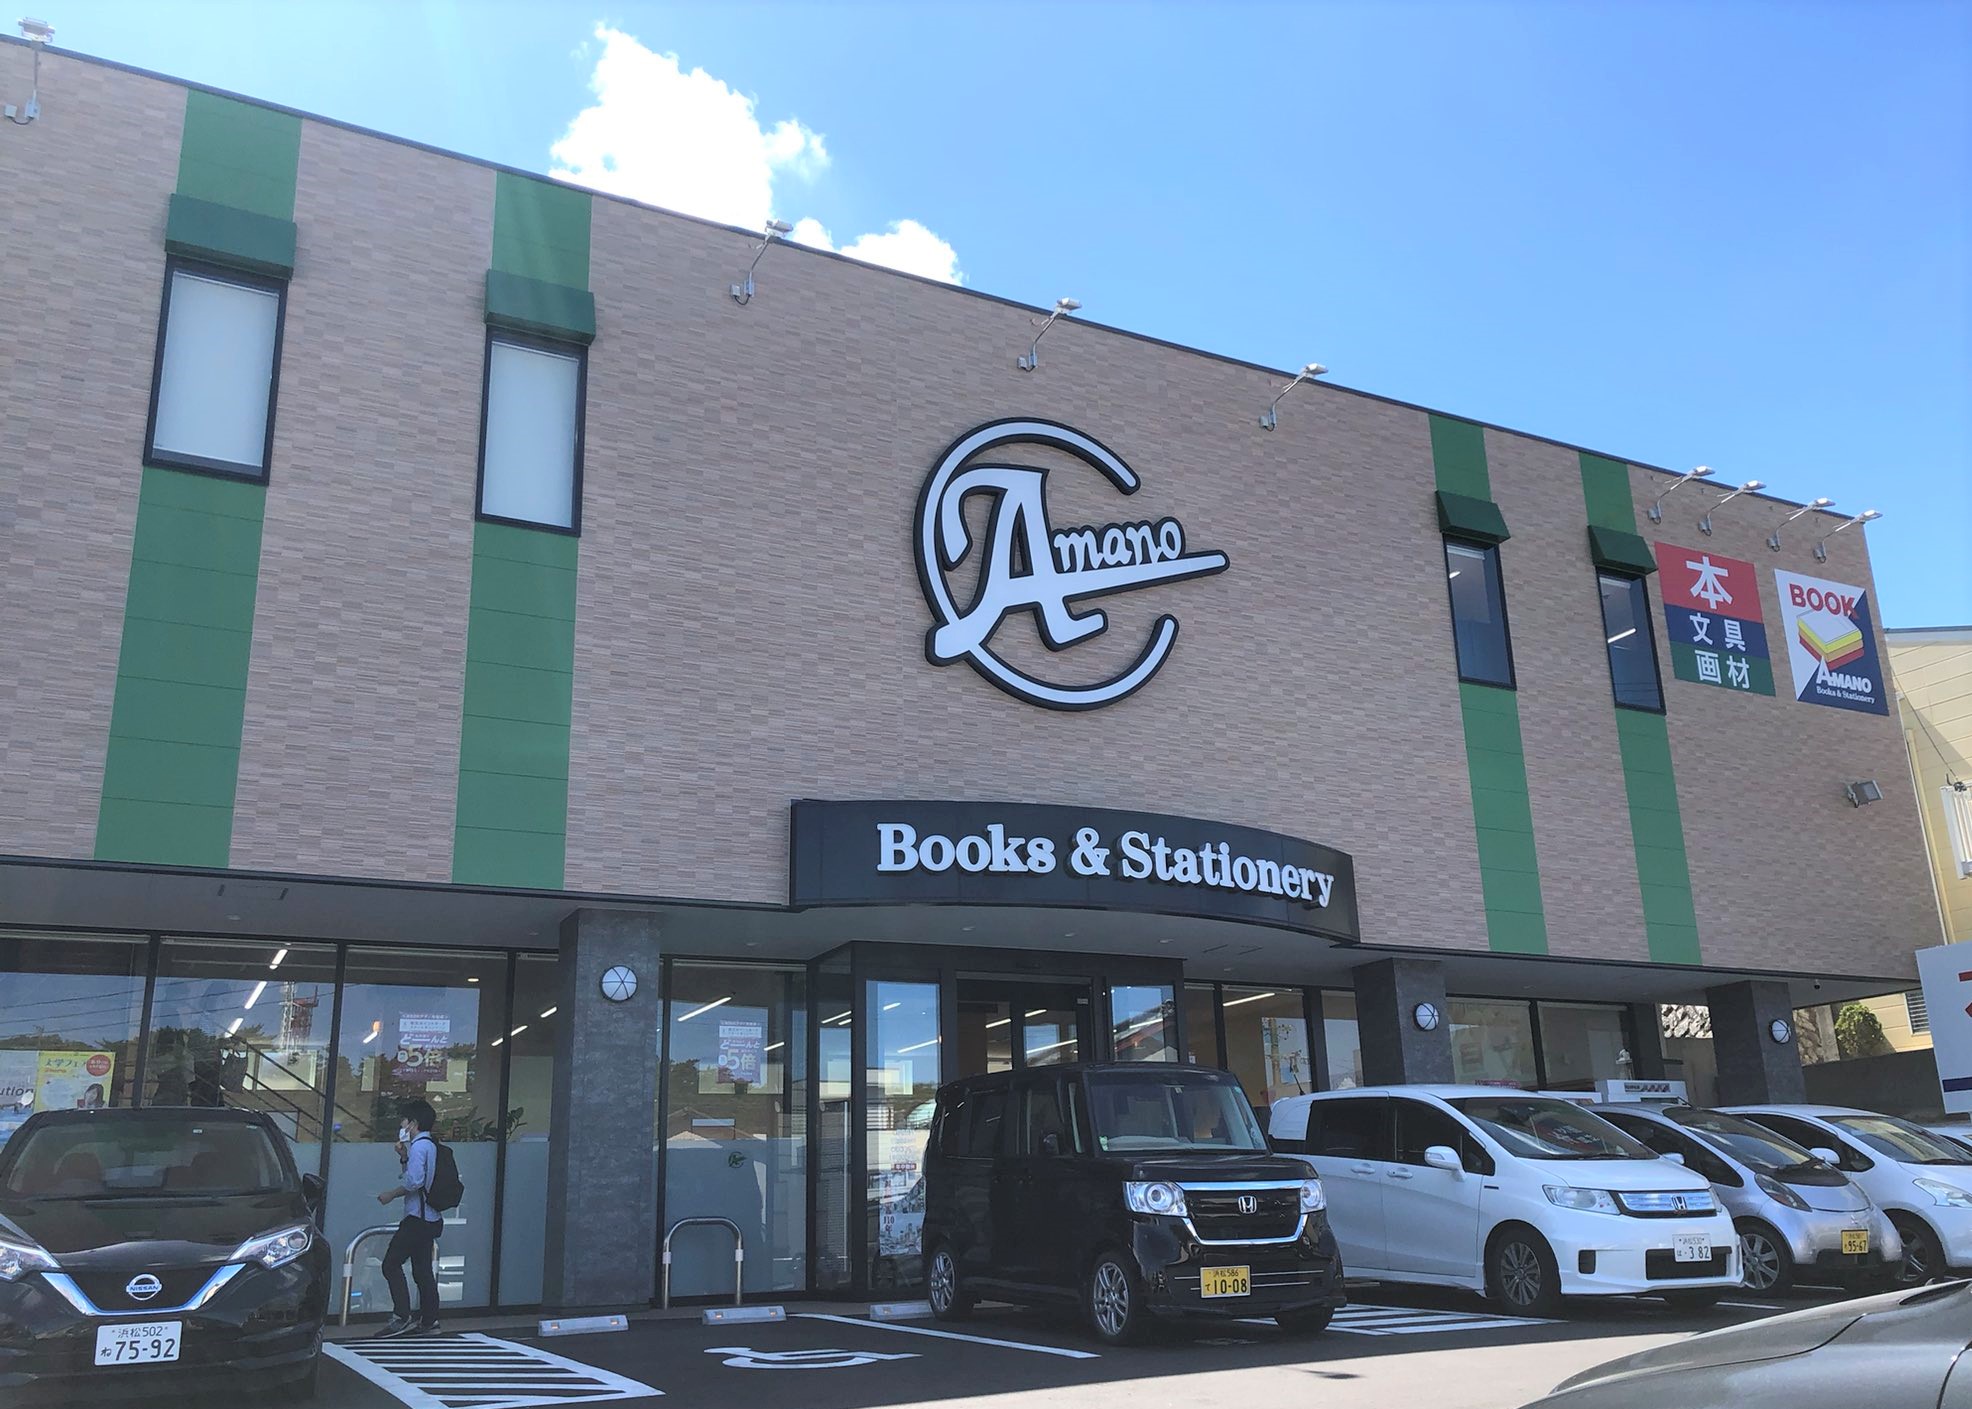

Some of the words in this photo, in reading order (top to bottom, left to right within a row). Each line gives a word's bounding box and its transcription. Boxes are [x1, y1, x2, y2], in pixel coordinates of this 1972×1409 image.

[1686, 555, 1733, 610] 本
[1789, 583, 1859, 619] BOOK
[1689, 612, 1746, 651] 文具
[1694, 649, 1750, 689] 画材
[1816, 685, 1836, 697] Books
[1842, 690, 1875, 704] Stationery
[876, 823, 1057, 875] Books
[1070, 826, 1110, 876] &
[1122, 830, 1335, 908] Stationery
[129, 1284, 159, 1292] NISSAN
[1214, 1278, 1247, 1294] 10-08
[118, 1326, 163, 1338] 浜松502
[101, 1347, 112, 1357] ね
[115, 1338, 176, 1361] 75-92
